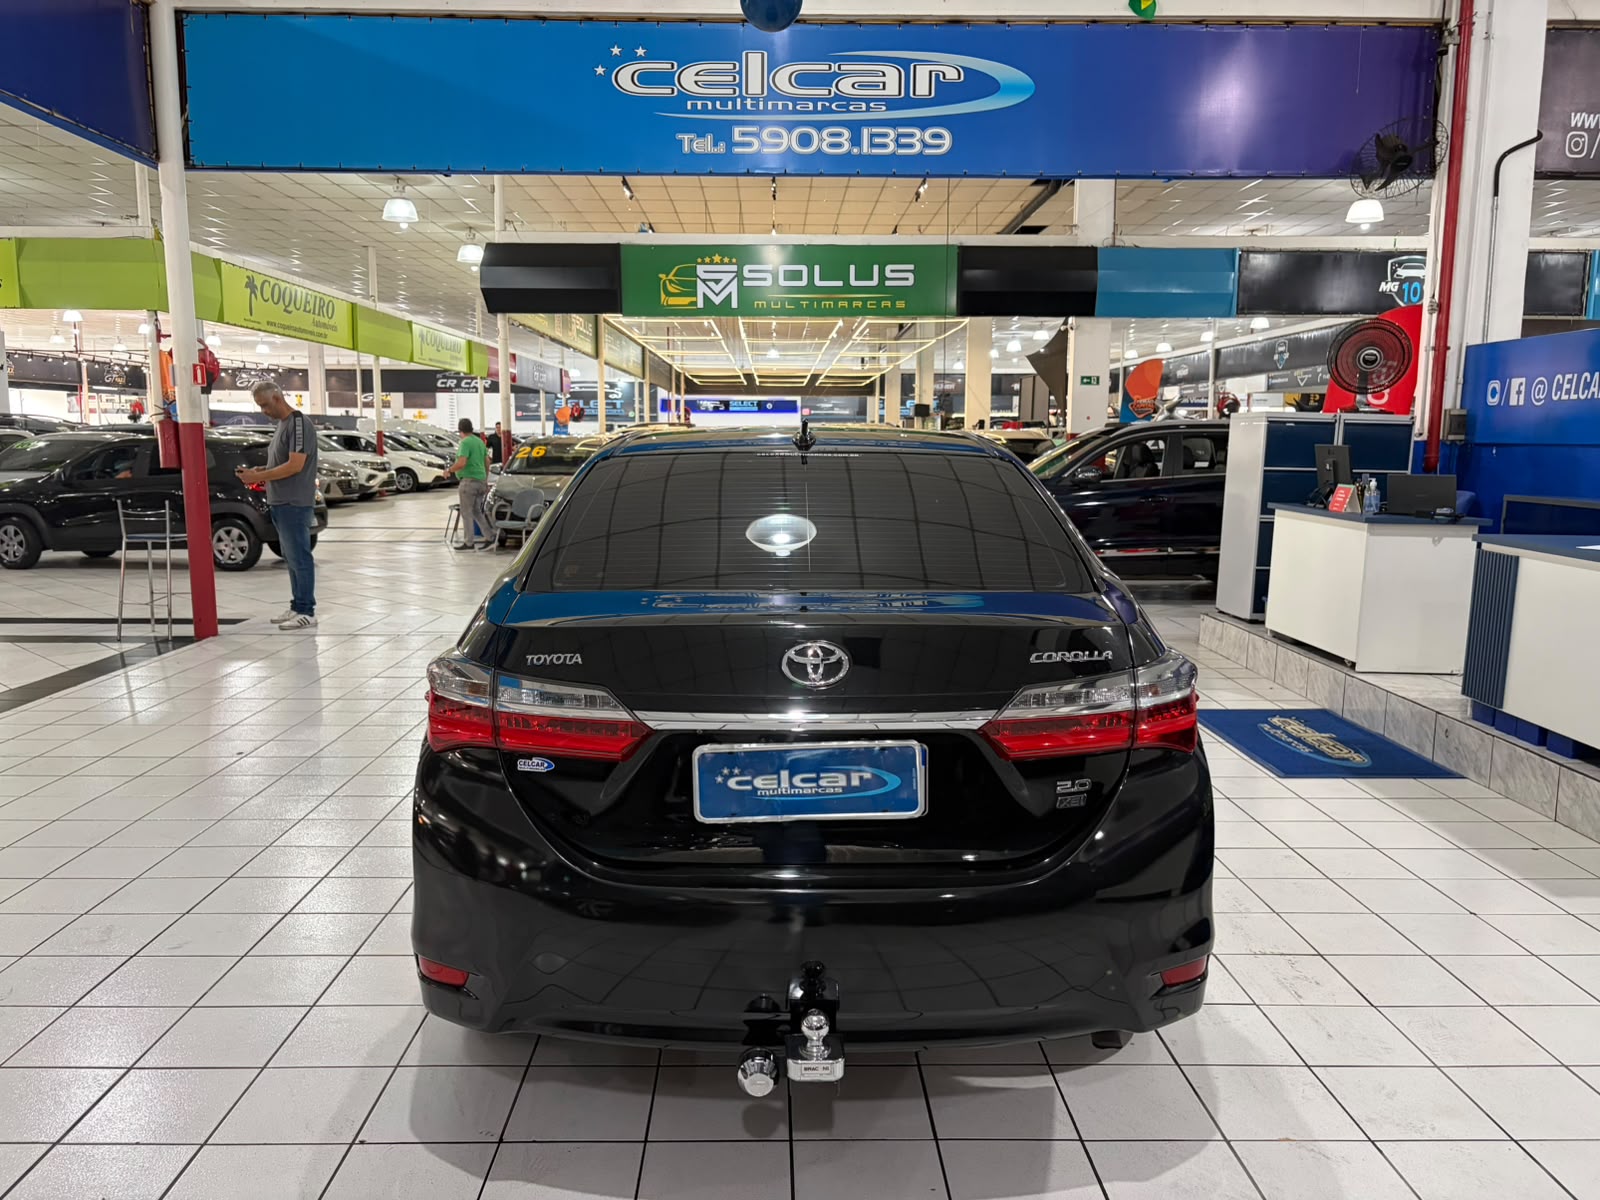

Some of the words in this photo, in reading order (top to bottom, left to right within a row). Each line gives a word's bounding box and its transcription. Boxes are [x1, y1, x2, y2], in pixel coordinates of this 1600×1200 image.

[612, 50, 965, 98] celcar
[686, 98, 887, 112] multimarcas
[732, 126, 952, 155] 5908.1339
[742, 264, 915, 287] SOLUS
[1378, 281, 1400, 292] MG
[260, 279, 335, 320] COQUEIRO
[754, 300, 906, 310] MULTIMARCAS
[436, 379, 457, 388] CR
[460, 380, 492, 388] CAR
[1551, 371, 1600, 401] CELCA
[515, 446, 547, 459] 26
[525, 653, 583, 666] TOYOTA
[1029, 650, 1113, 664] COROLLA
[518, 760, 546, 768] CELCAR
[727, 770, 872, 790] celcar
[1056, 779, 1092, 793] 2.0
[757, 786, 843, 796] multimarcas
